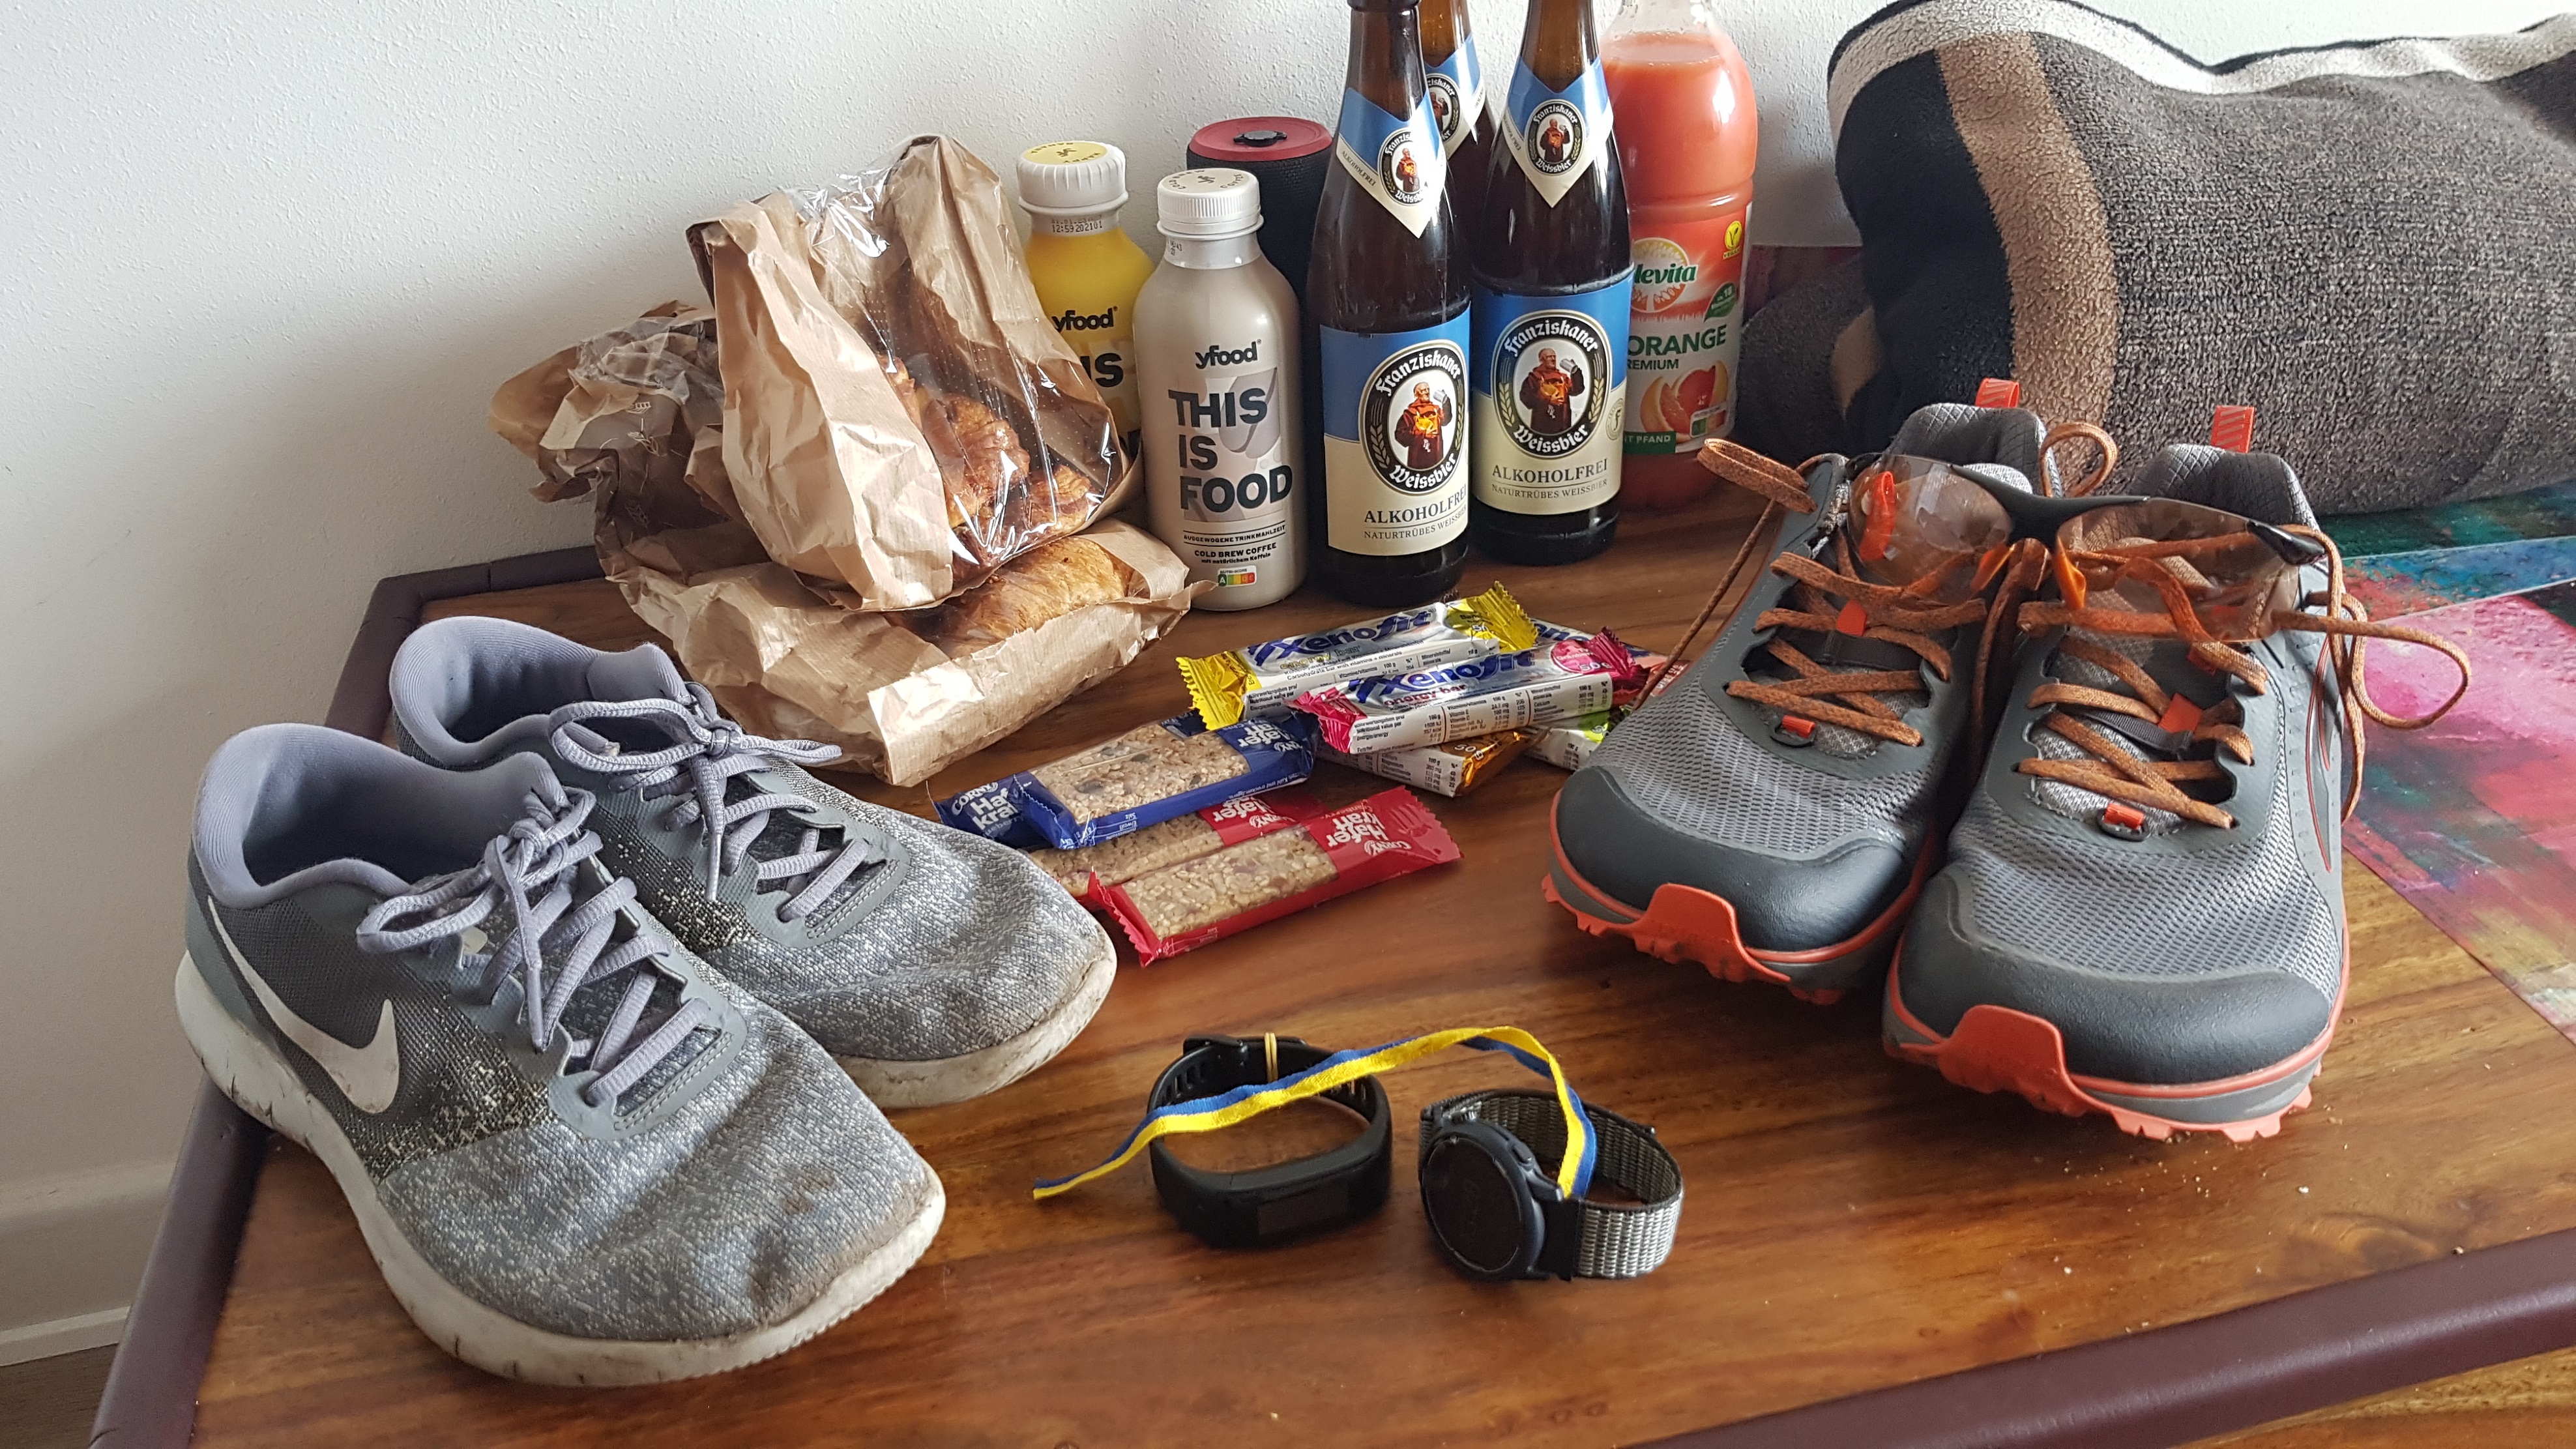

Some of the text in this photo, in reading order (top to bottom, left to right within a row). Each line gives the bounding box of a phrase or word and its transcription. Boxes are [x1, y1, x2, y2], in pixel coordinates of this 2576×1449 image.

[1533, 104, 1577, 124] Franziskaner
[1341, 149, 1377, 187] ALKOHOLFREI
[1535, 158, 1572, 173] Weissbier
[1633, 263, 1697, 285] levita
[1051, 308, 1114, 333] yfood
[1504, 319, 1598, 357] Franziskaner
[1195, 341, 1258, 369] yfood
[1627, 359, 1679, 370] REMIUM
[1376, 351, 1461, 396] Franziskaner
[1167, 388, 1268, 428] THIS
[1513, 424, 1588, 454] Weissbier
[1636, 435, 1671, 444] PFAND
[1178, 434, 1218, 471] IS
[1389, 452, 1457, 489] Weissbier
[1492, 458, 1607, 484] ALKOHOLFREI
[1180, 465, 1293, 513] FOOD
[1491, 478, 1607, 499] NATURTRÜBES WEISSBIER
[1364, 484, 1467, 523] ALKOHOLFREI
[1183, 525, 1286, 543] AUSGEWOGENE TRINKMAHLZEIT
[1364, 525, 1436, 540] NATURTRÜBES
[1246, 542, 1277, 555] COFFEE
[1579, 662, 1601, 671] 50
[951, 782, 999, 815] CORNY
[1332, 812, 1386, 832] kraft
[1326, 824, 1388, 847] Hafer
[1364, 841, 1411, 856] CORNY
